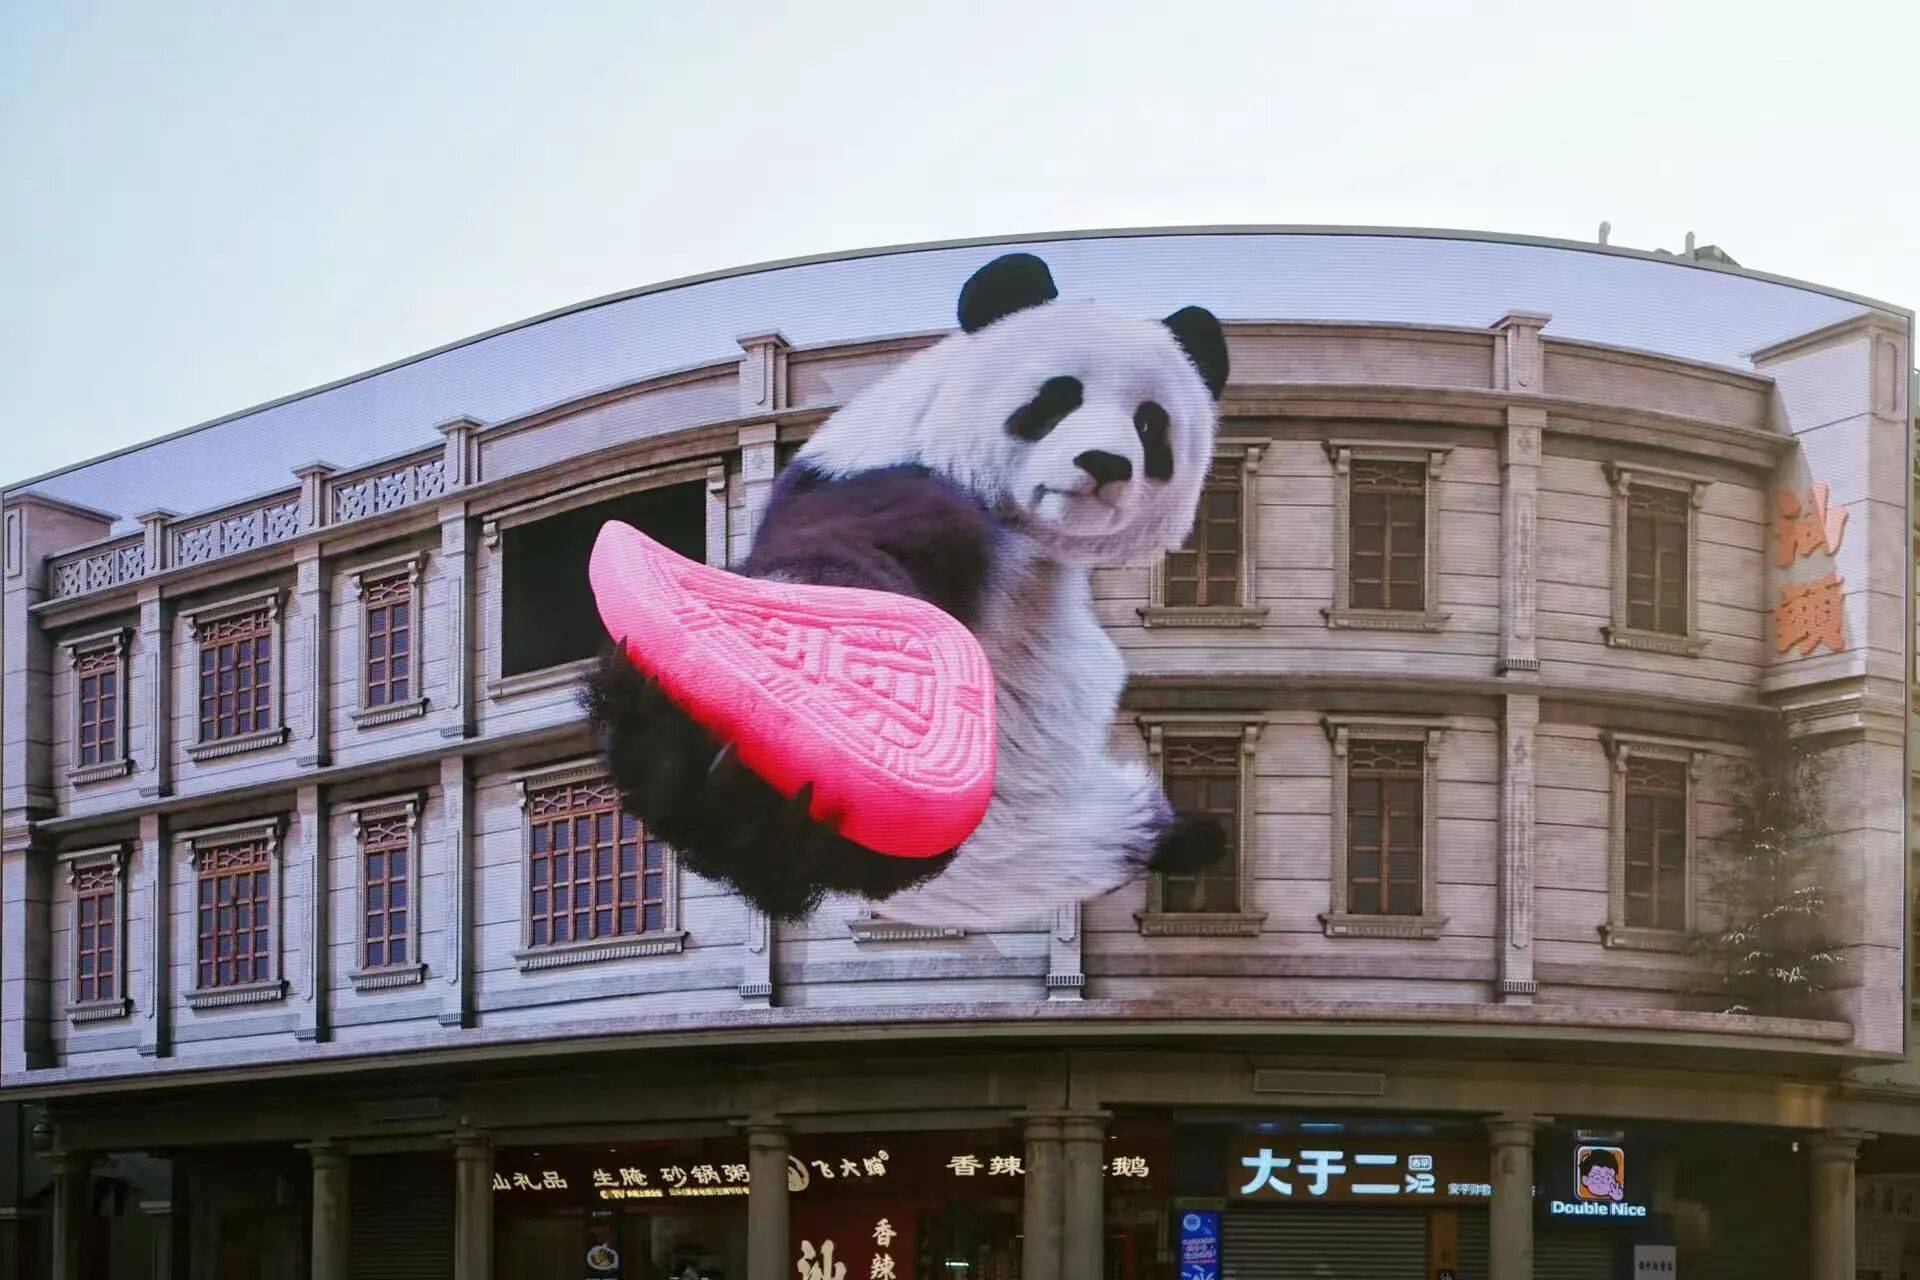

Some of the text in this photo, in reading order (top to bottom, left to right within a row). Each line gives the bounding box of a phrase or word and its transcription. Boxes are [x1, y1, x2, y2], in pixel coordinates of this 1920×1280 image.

[593, 1167, 648, 1187] 生腌
[660, 1163, 750, 1189] 砂锅粥
[1241, 1148, 1400, 1196] 大于二
[1551, 1200, 1647, 1217] Double Nice
